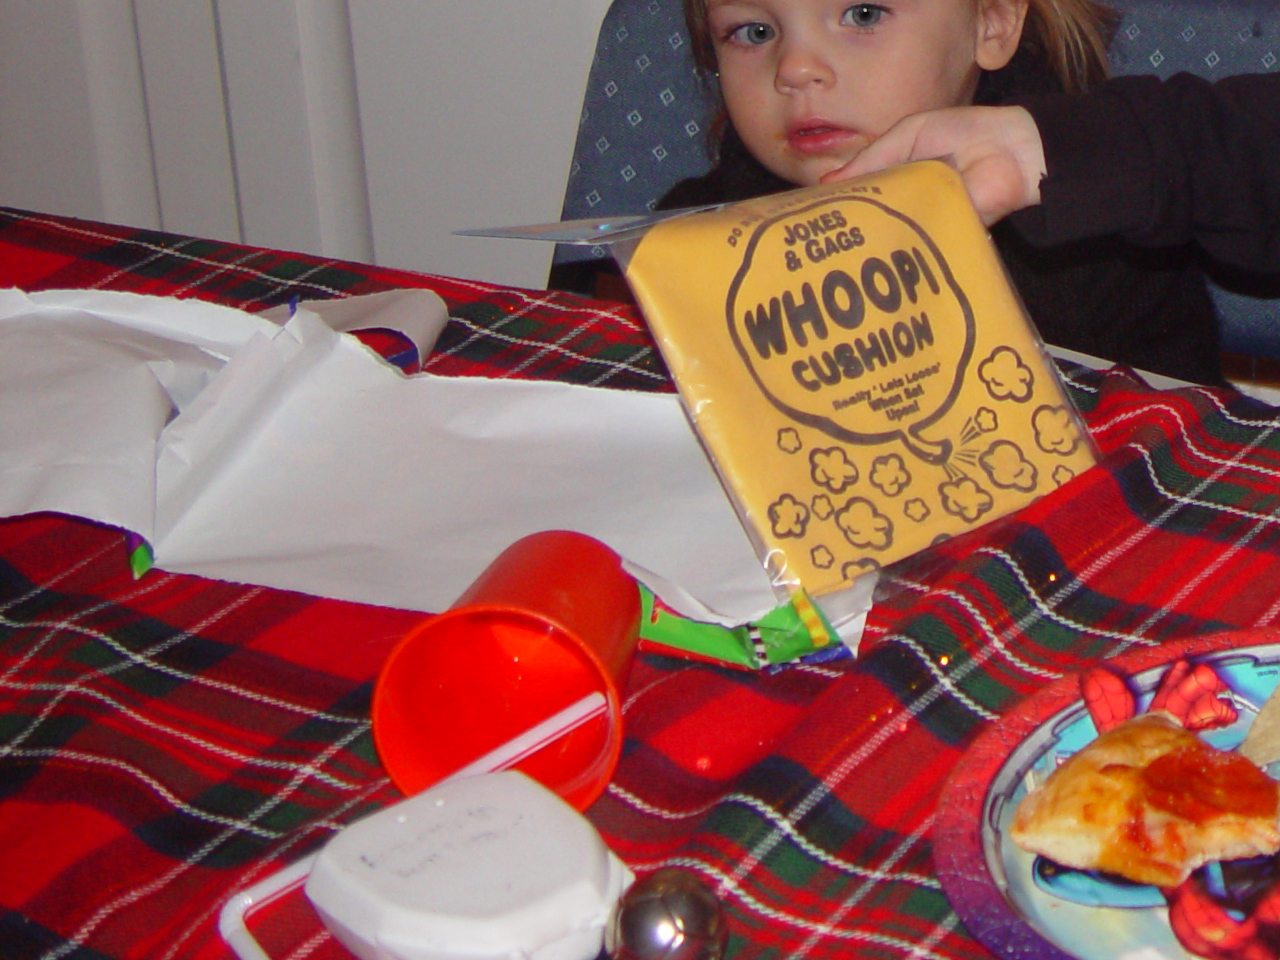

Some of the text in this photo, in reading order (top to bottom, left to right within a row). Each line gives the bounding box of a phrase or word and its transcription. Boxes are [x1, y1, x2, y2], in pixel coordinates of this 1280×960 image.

[784, 210, 848, 246] JOKES
[784, 227, 866, 272] & GAGS
[744, 246, 941, 360] WHOOPI
[791, 311, 935, 392] CUSHION
